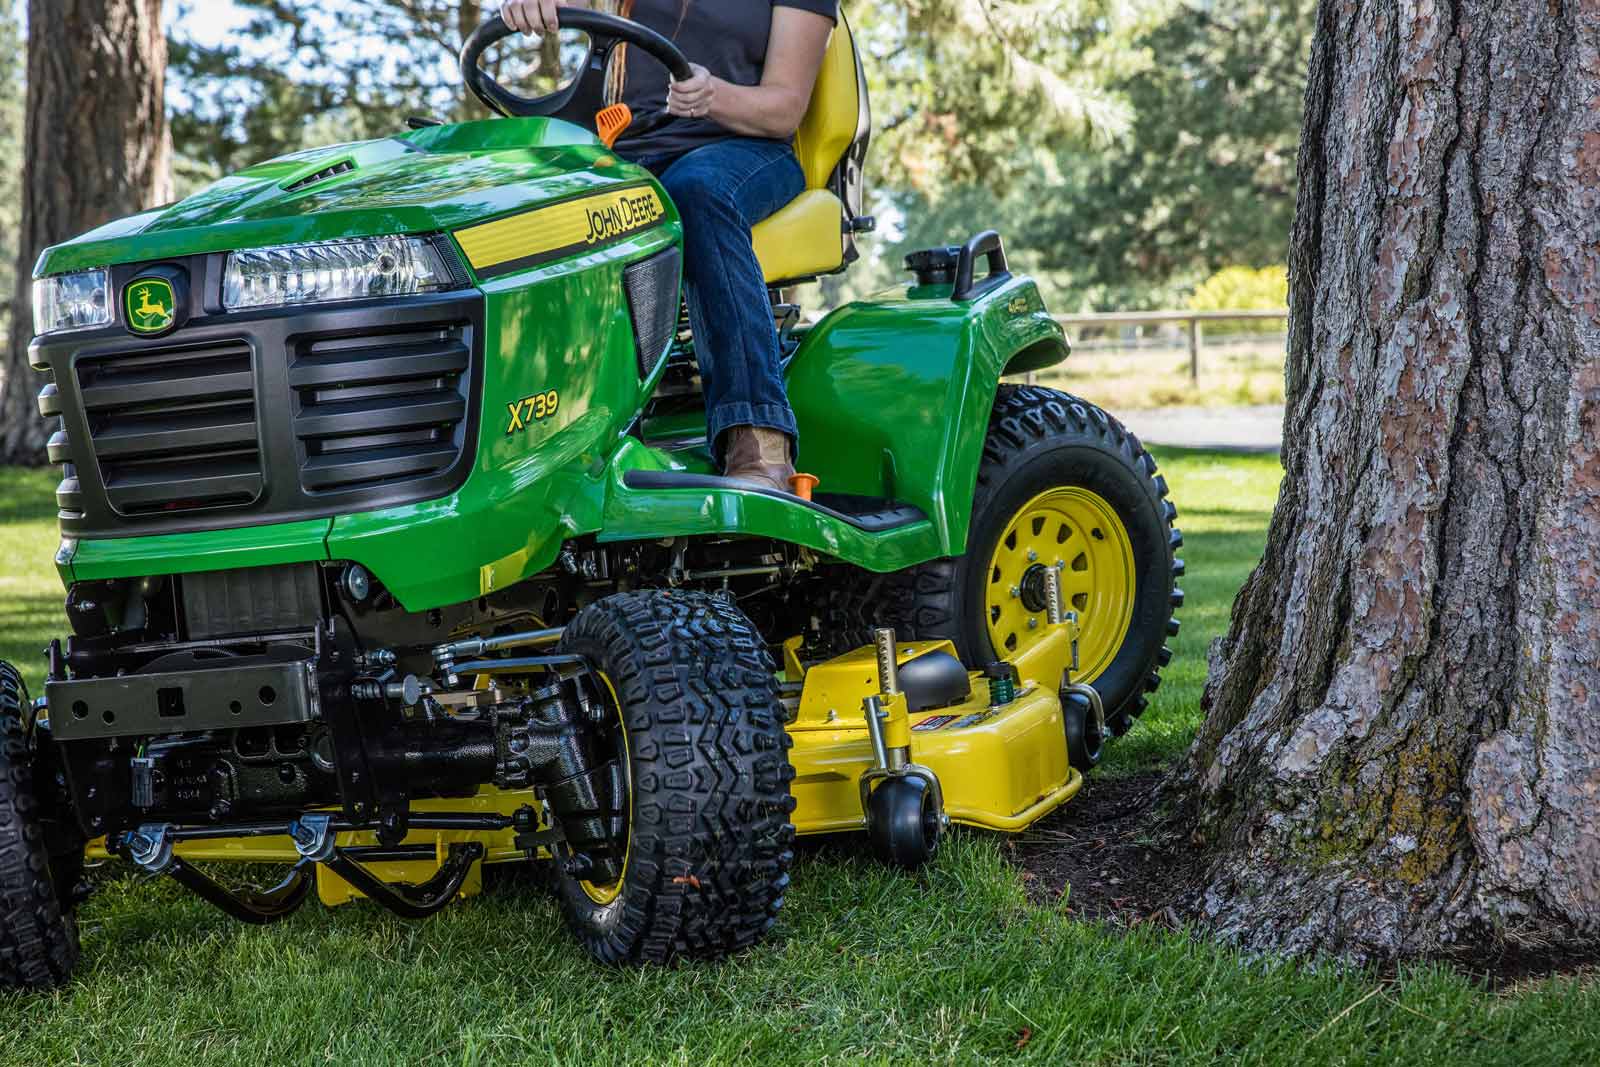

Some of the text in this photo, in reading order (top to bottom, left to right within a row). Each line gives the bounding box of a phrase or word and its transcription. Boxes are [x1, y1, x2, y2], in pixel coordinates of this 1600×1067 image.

[585, 194, 657, 240] JOHN DEERE
[507, 389, 559, 434] X739
